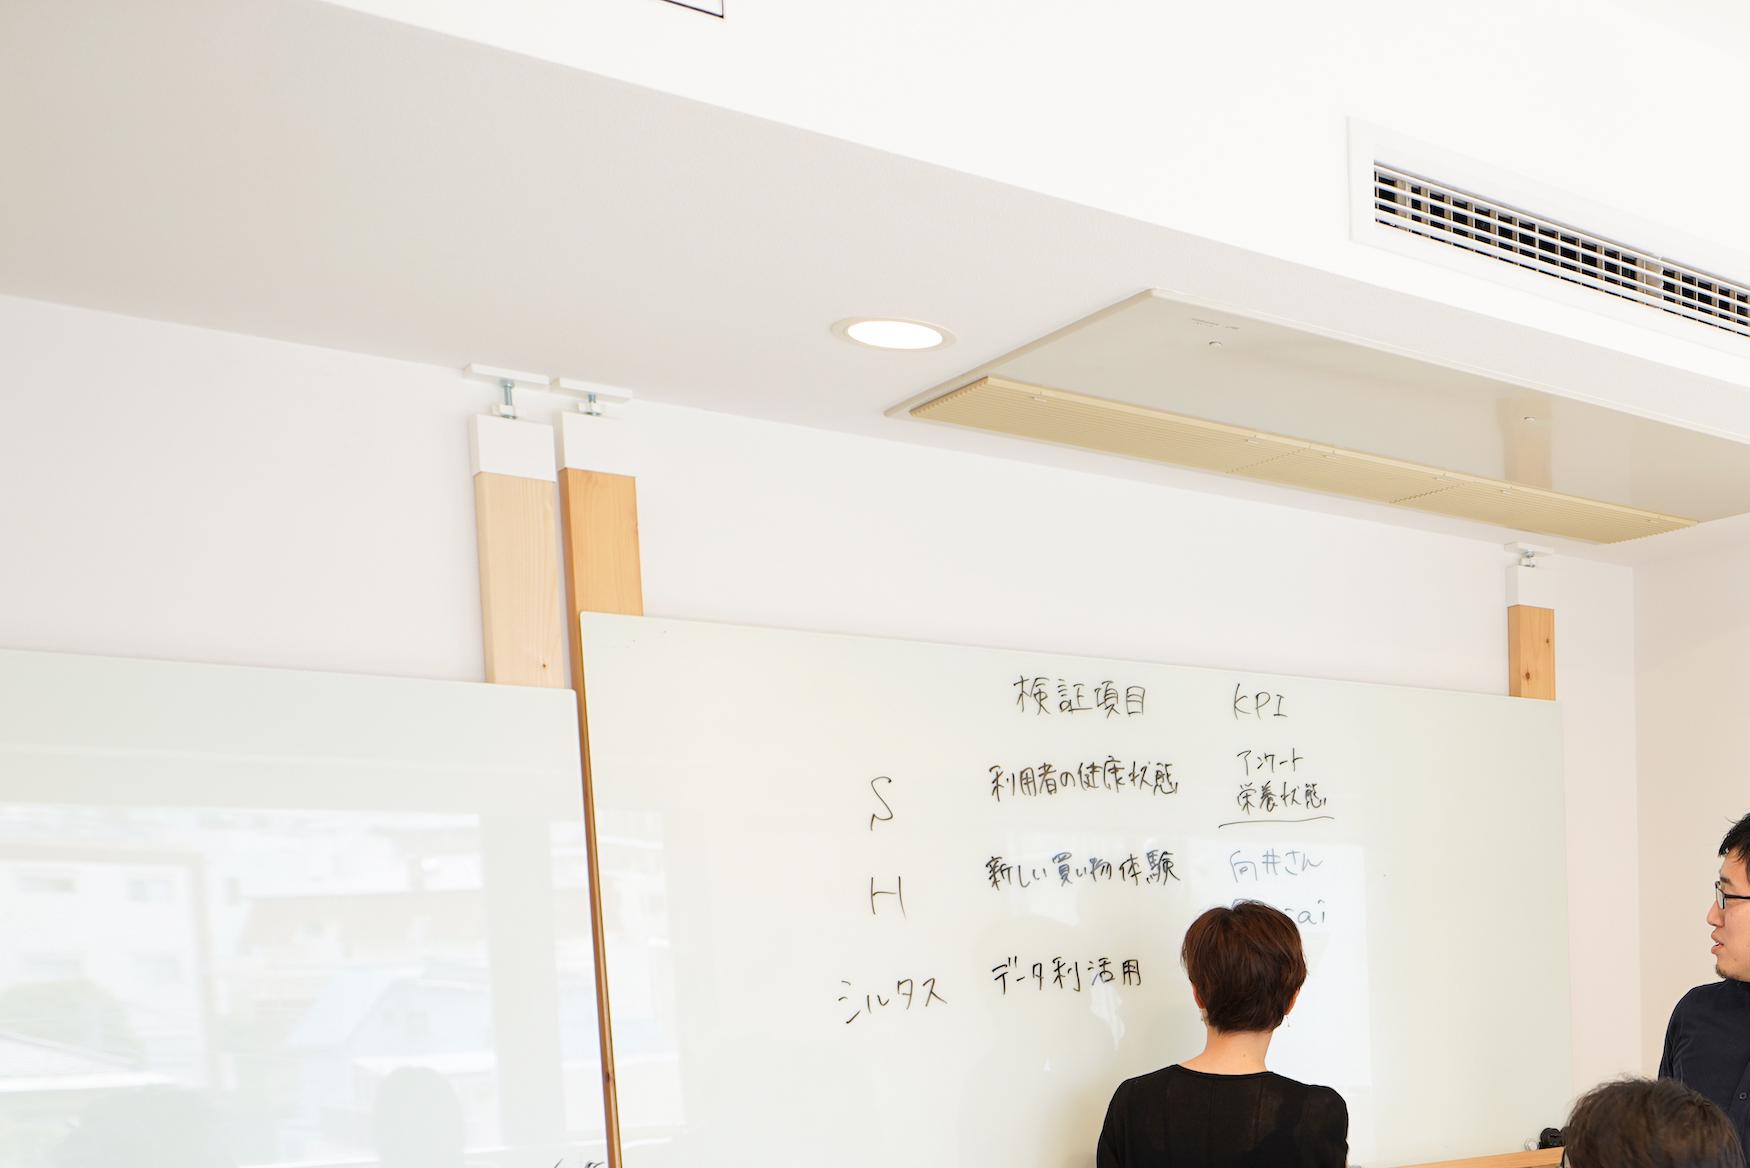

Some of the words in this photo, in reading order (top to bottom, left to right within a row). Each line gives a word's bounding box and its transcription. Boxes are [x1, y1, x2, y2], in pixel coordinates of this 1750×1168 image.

[1012, 675, 1146, 719] 検証項目
[1232, 684, 1288, 720] KPI
[988, 755, 1180, 802] 利用者の健康状態
[1236, 748, 1304, 776] アンケート
[870, 776, 893, 831] S
[1236, 780, 1327, 815] 栄養状態
[985, 849, 1181, 891] 新しい買い物体験
[1230, 849, 1324, 883] 向井さん
[870, 875, 907, 920] H
[991, 956, 1142, 995] データ利活用
[838, 977, 949, 1025] シルタス
